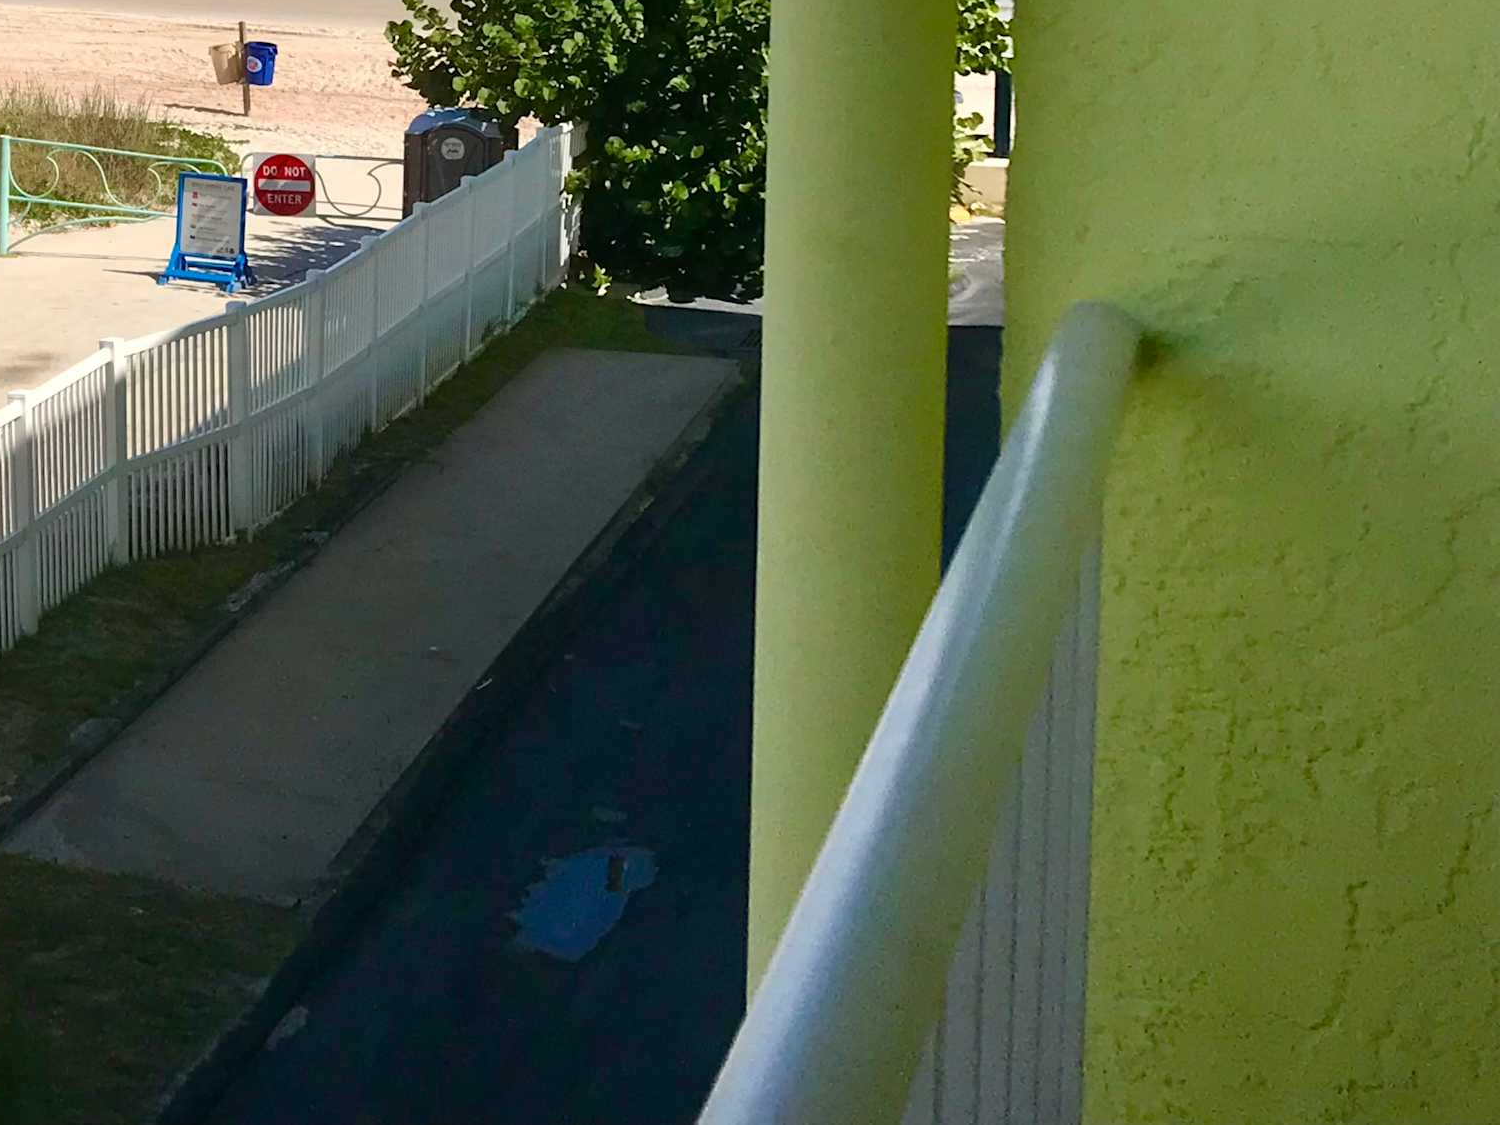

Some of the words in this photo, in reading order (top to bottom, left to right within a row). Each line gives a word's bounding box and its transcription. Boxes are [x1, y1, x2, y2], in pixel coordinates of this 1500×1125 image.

[262, 165, 277, 176] DO
[284, 166, 306, 177] NOT
[267, 194, 302, 204] ENTER
